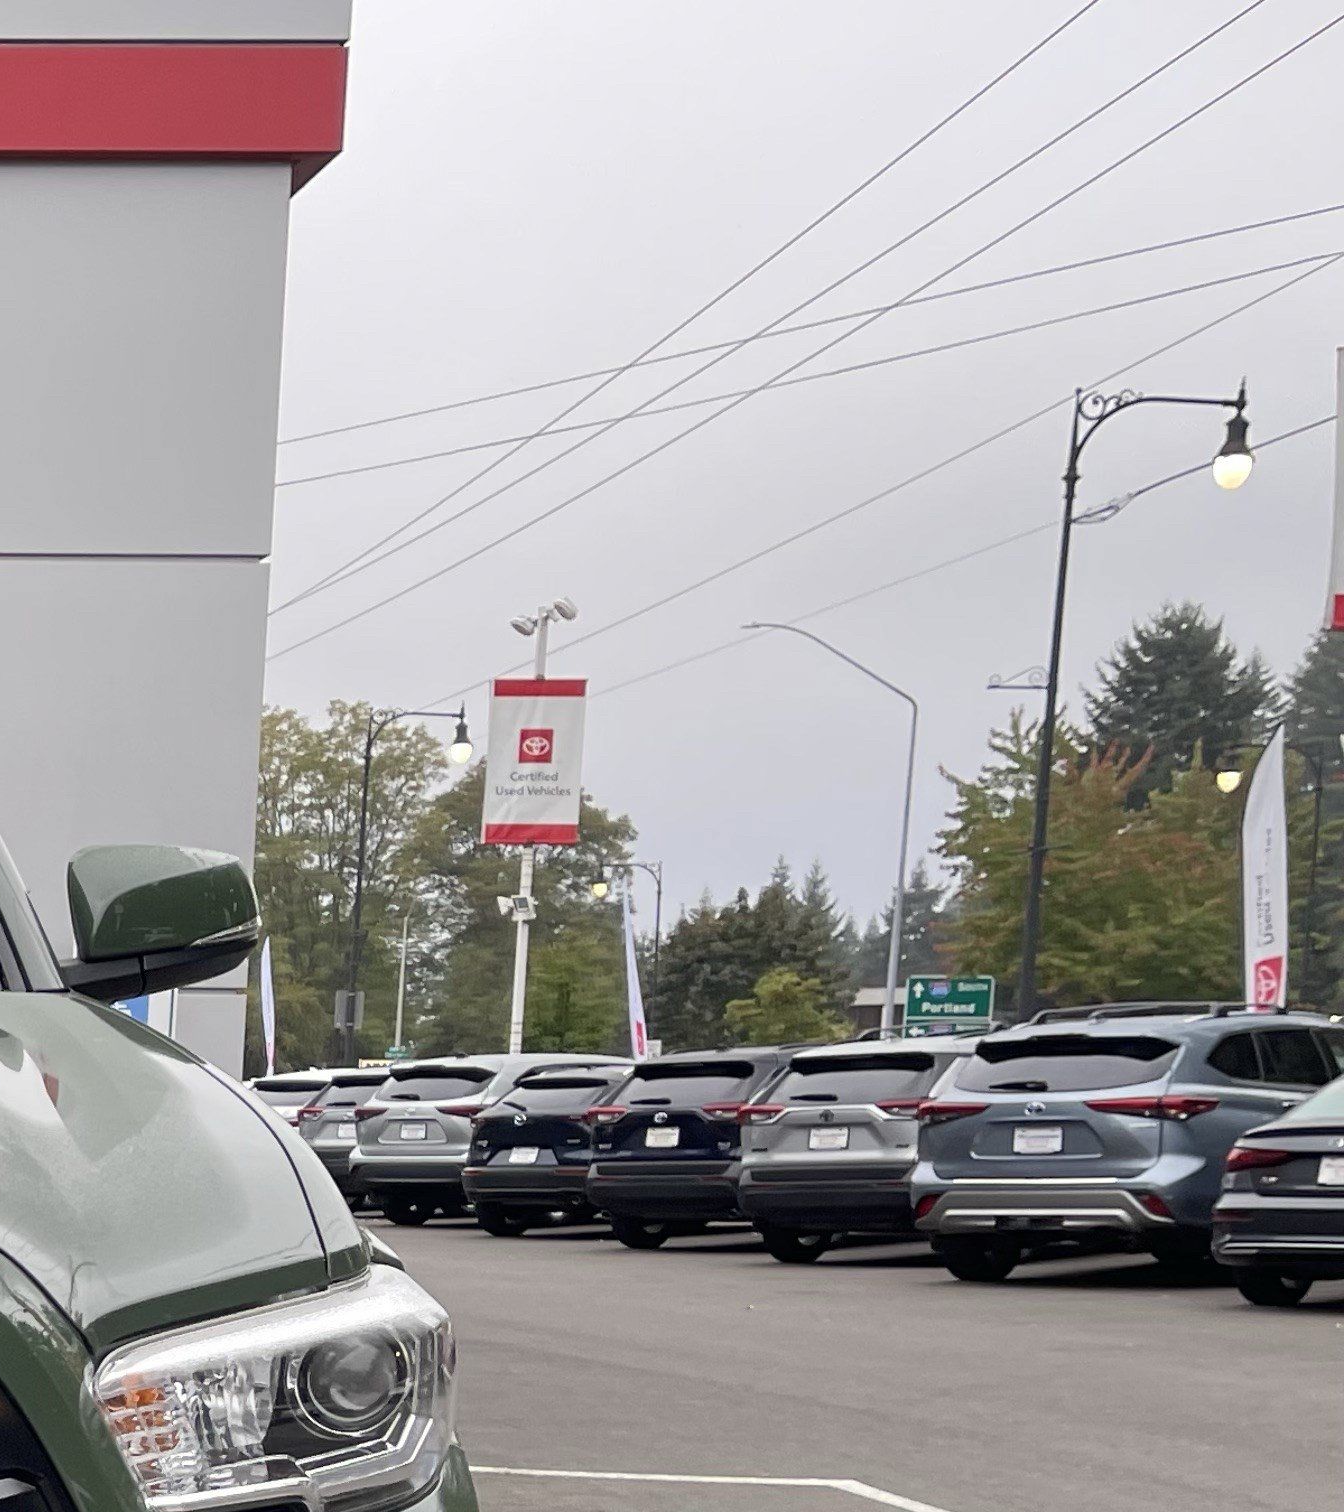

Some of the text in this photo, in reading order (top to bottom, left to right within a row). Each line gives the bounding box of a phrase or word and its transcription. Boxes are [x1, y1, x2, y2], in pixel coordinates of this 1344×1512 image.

[509, 770, 559, 782] Certified
[495, 785, 571, 797] Used Vehicles
[921, 1001, 976, 1014] Portland
